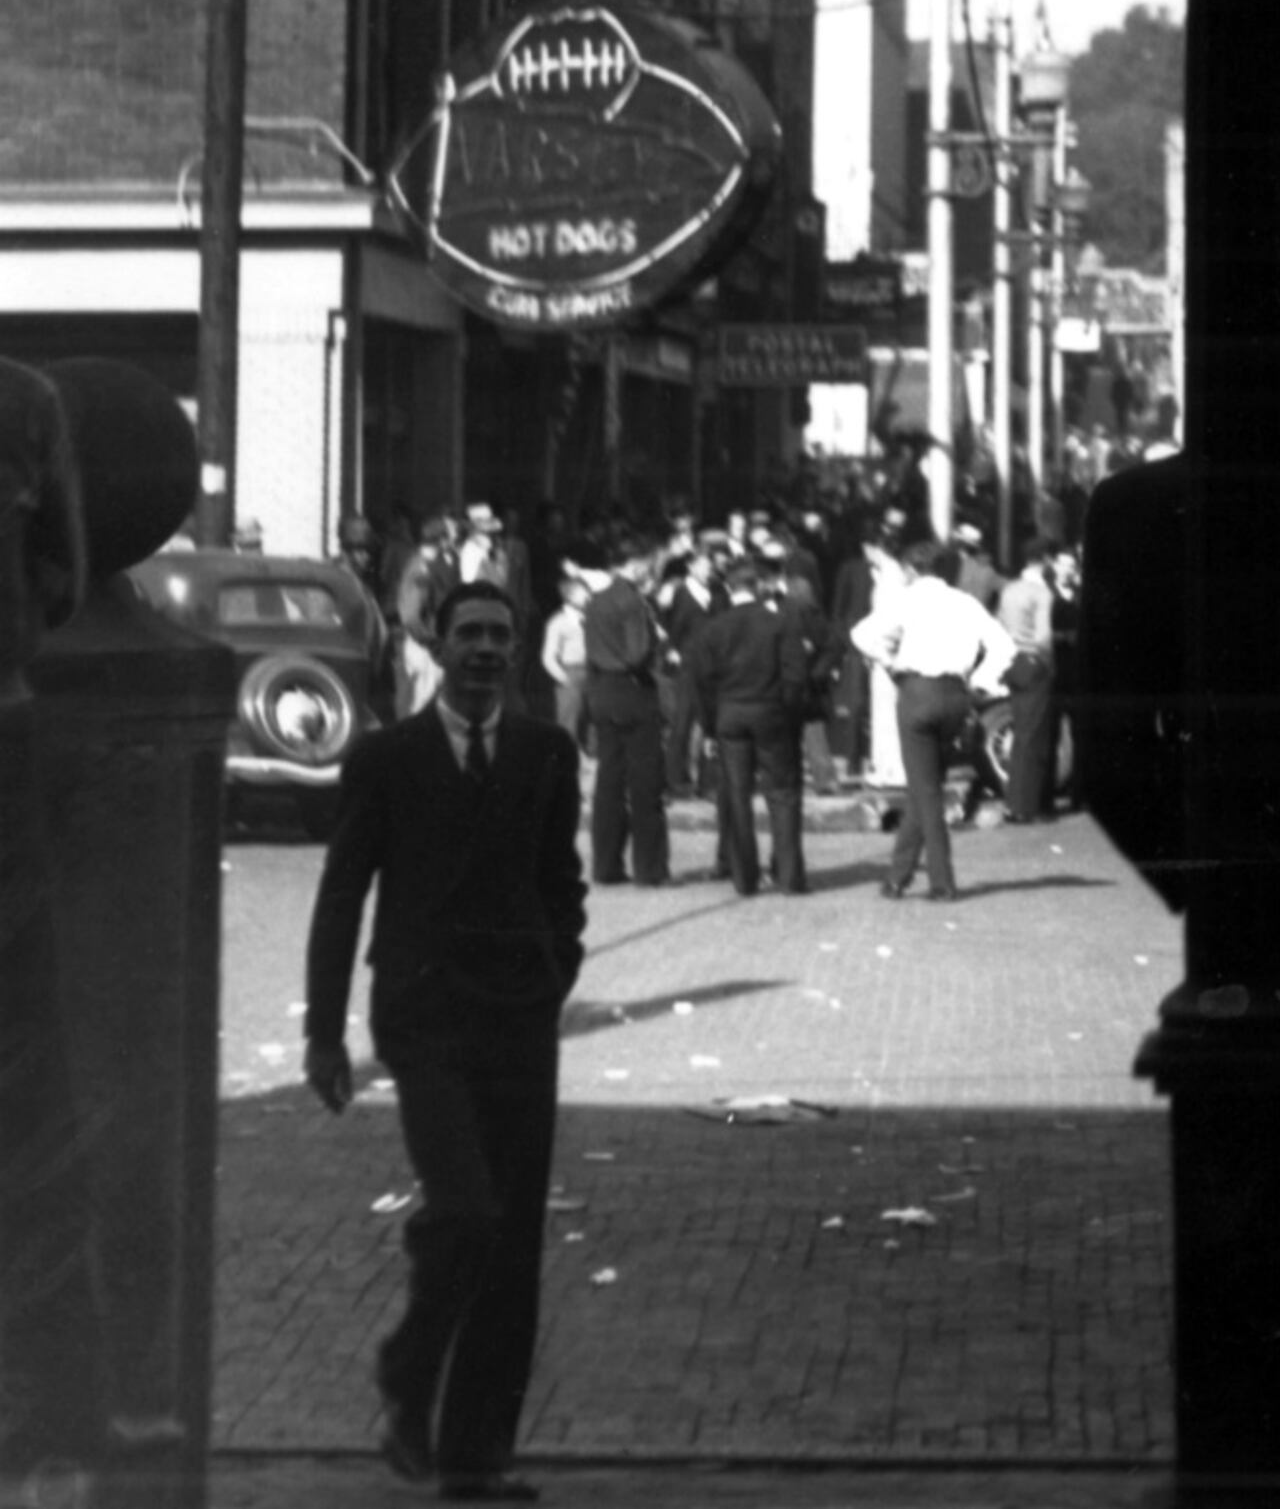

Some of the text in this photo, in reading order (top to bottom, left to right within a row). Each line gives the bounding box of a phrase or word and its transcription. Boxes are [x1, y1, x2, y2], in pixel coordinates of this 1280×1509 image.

[488, 217, 638, 260] HOT DOGS
[722, 354, 862, 380] TELEGRAPH
